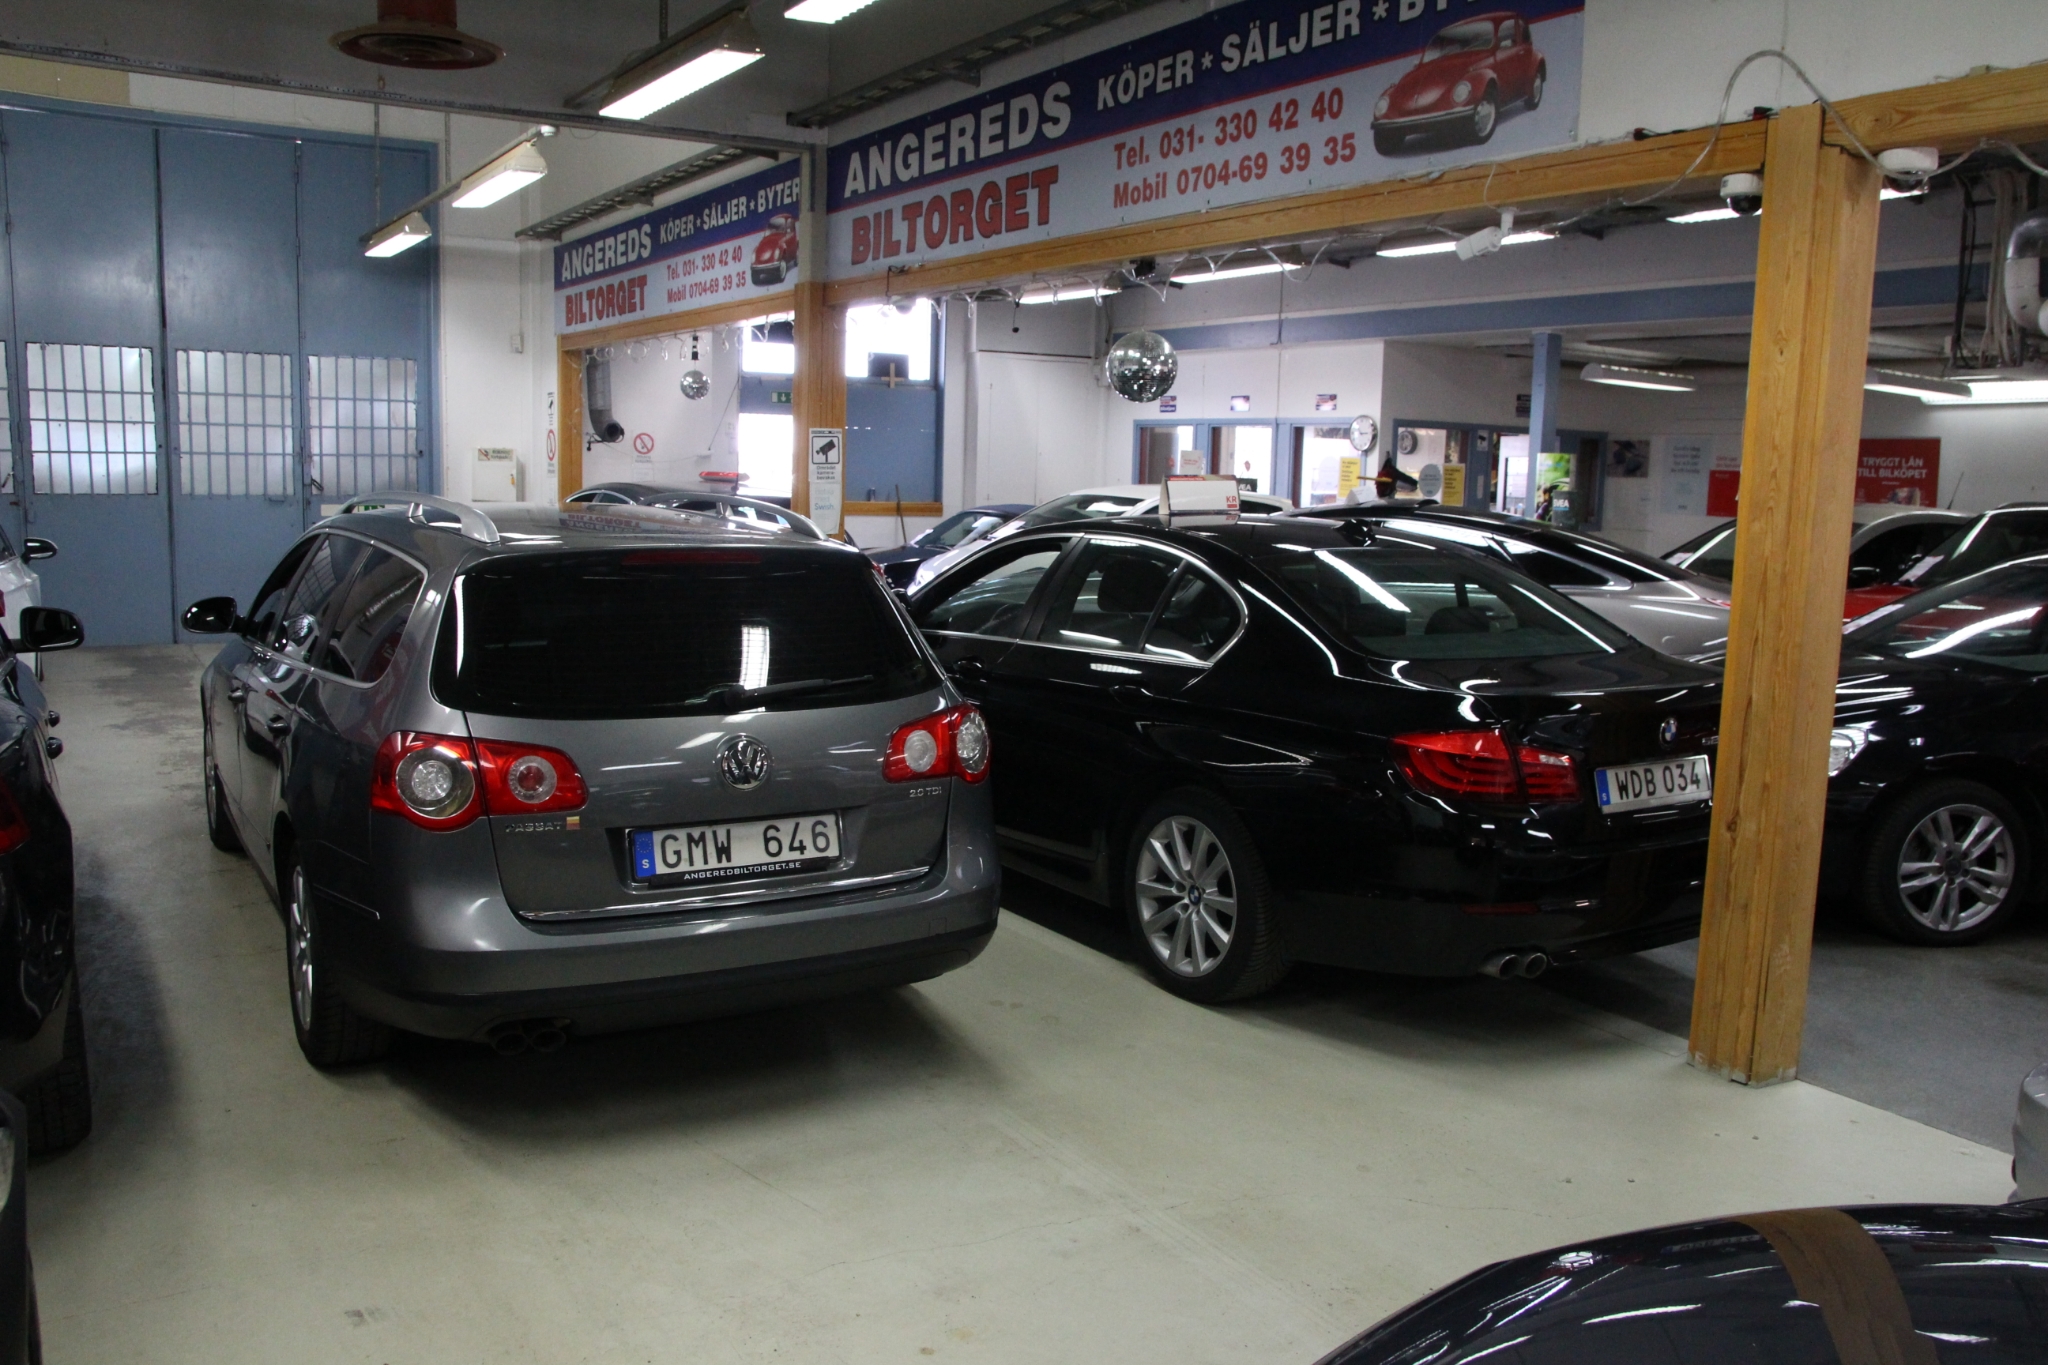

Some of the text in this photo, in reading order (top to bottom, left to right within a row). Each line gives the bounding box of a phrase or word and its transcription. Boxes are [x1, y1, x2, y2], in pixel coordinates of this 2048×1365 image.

[1097, 0, 1361, 111] KÖPER SÄLJER
[844, 80, 1072, 198] ANGEREDS
[1113, 86, 1345, 171] Tel. 031- 330 42 40
[1113, 132, 1357, 209] Mobil 0704-69 39 35
[659, 214, 694, 245] KÖPER
[702, 196, 748, 231] SÄLJER
[851, 164, 1060, 266] BILTORGET
[561, 223, 652, 283] ANGEREDS
[666, 264, 680, 281] Tel.
[701, 254, 716, 272] 330
[718, 249, 729, 267] 42
[731, 245, 743, 263] 40
[565, 273, 648, 327] BILTORGET
[667, 270, 747, 304] Mobil 0704-69 39 35
[1862, 457, 1900, 467] TRYGGT
[1878, 467, 1928, 479] BILKÖPET
[1225, 496, 1237, 504] KR
[926, 785, 942, 796] TDI
[1615, 761, 1701, 801] WDB 034
[505, 821, 563, 833] PASSAT
[660, 819, 831, 869] GMW 646
[641, 859, 650, 869] S
[684, 861, 801, 881] ANGEREDBILTORGET.SE
